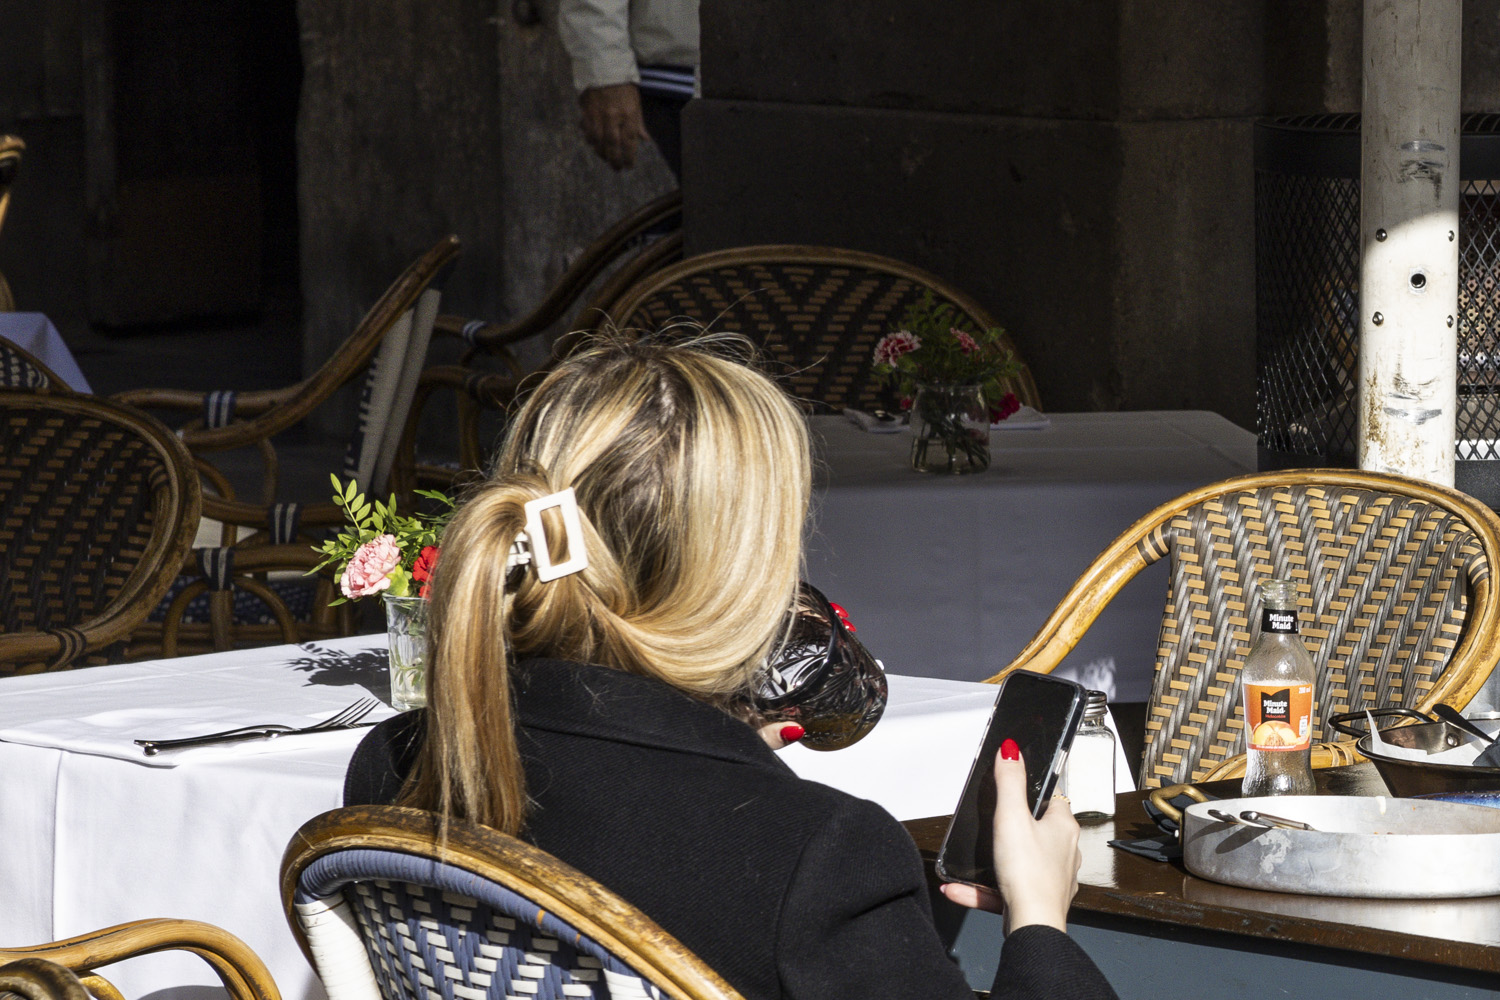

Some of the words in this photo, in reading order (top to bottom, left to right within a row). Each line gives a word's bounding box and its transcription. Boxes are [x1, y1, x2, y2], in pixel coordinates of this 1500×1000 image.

[1269, 613, 1294, 623] Minute
[1271, 621, 1292, 630] Maid
[1263, 699, 1288, 708] Minute
[1266, 706, 1286, 714] Maid
